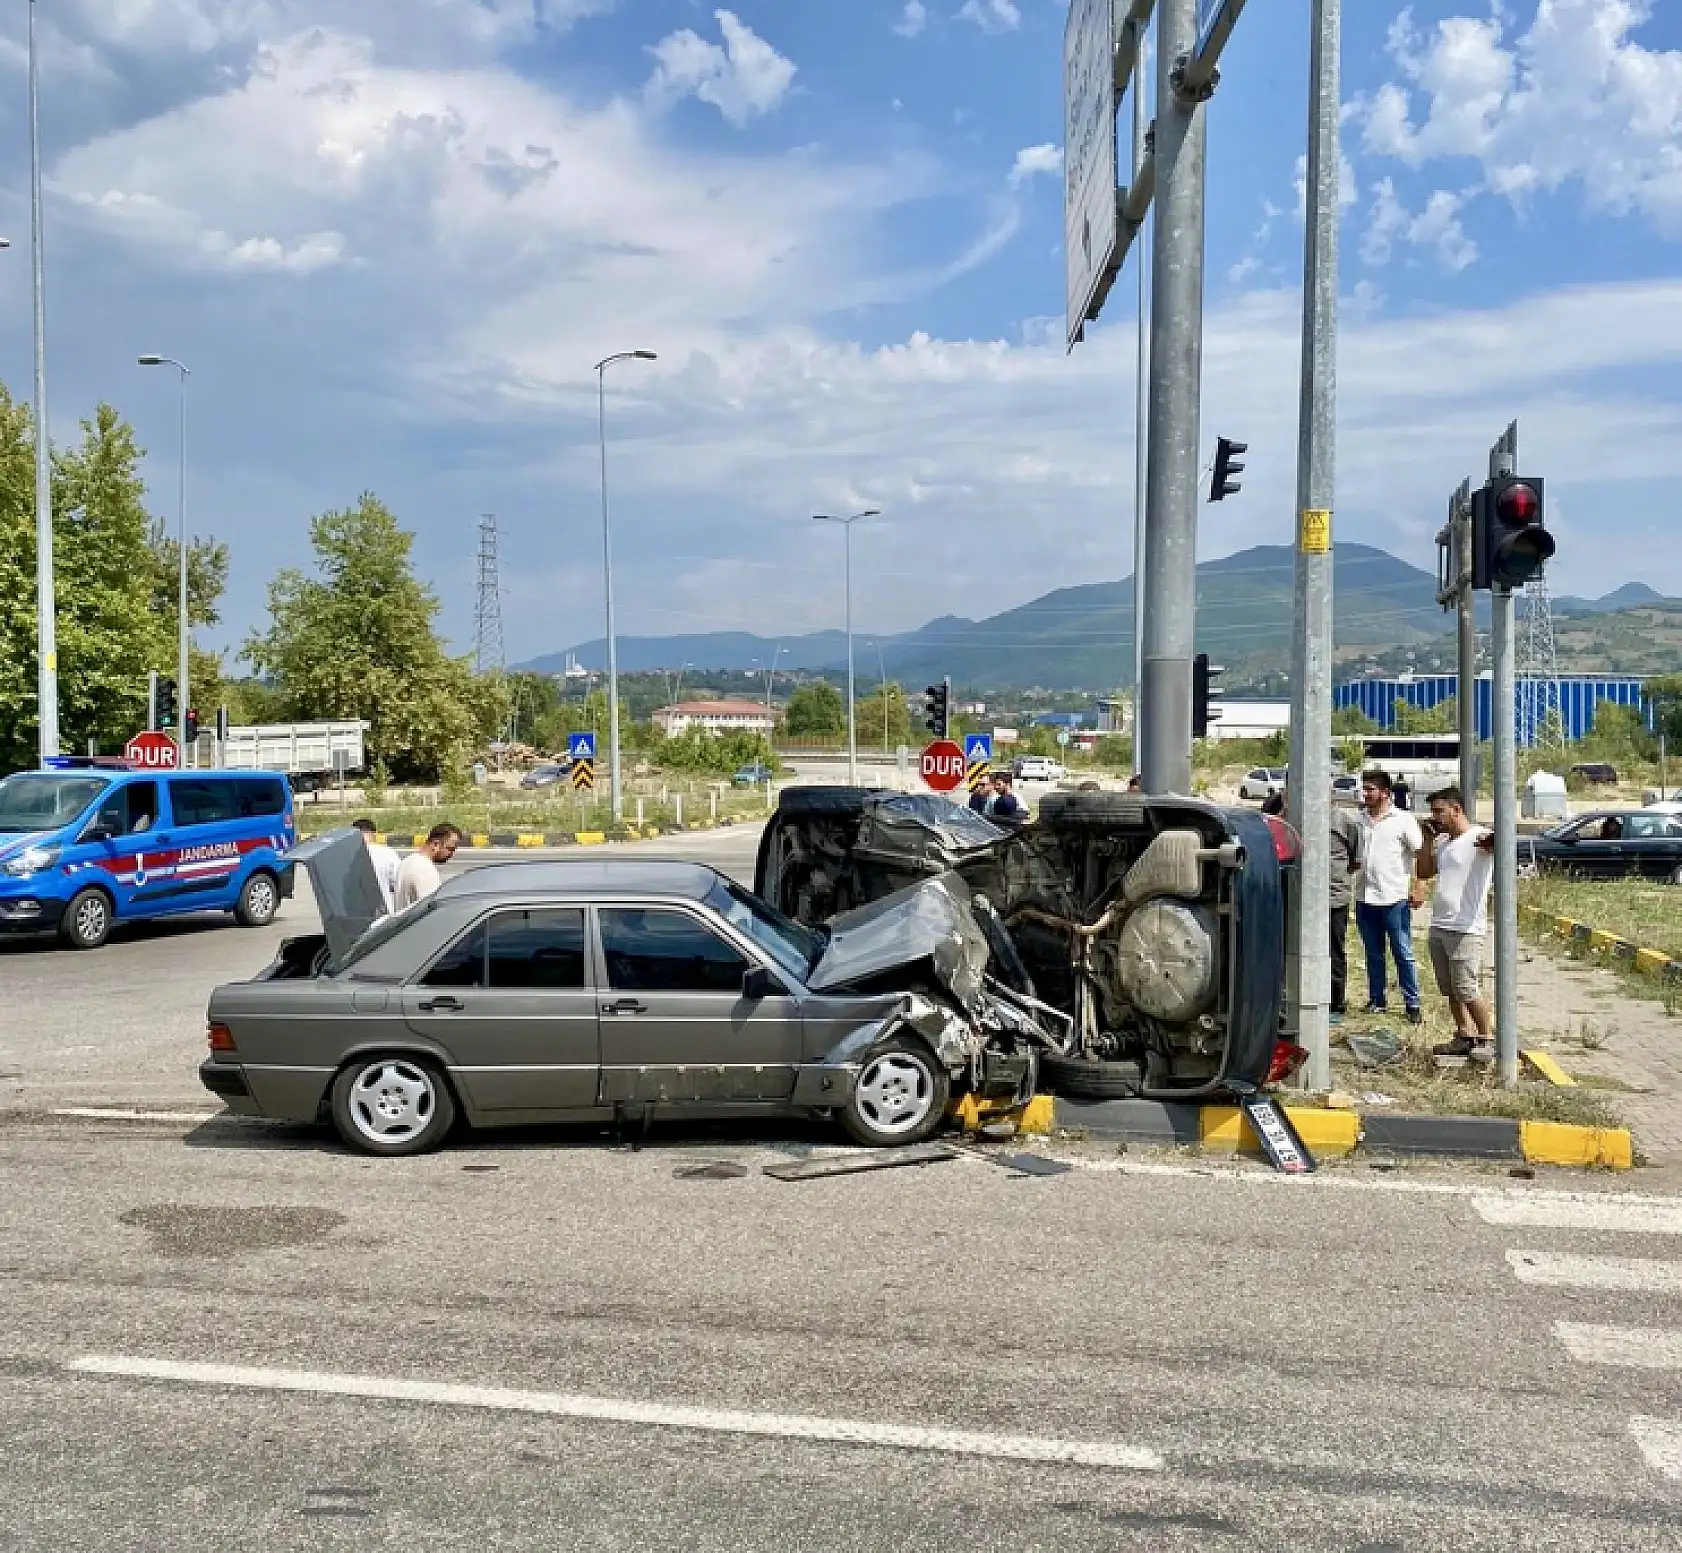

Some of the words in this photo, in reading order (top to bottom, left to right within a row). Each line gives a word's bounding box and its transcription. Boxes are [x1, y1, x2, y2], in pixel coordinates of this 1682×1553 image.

[130, 746, 174, 766] DUR
[923, 755, 963, 776] DUR
[178, 841, 240, 863] JANDARMA
